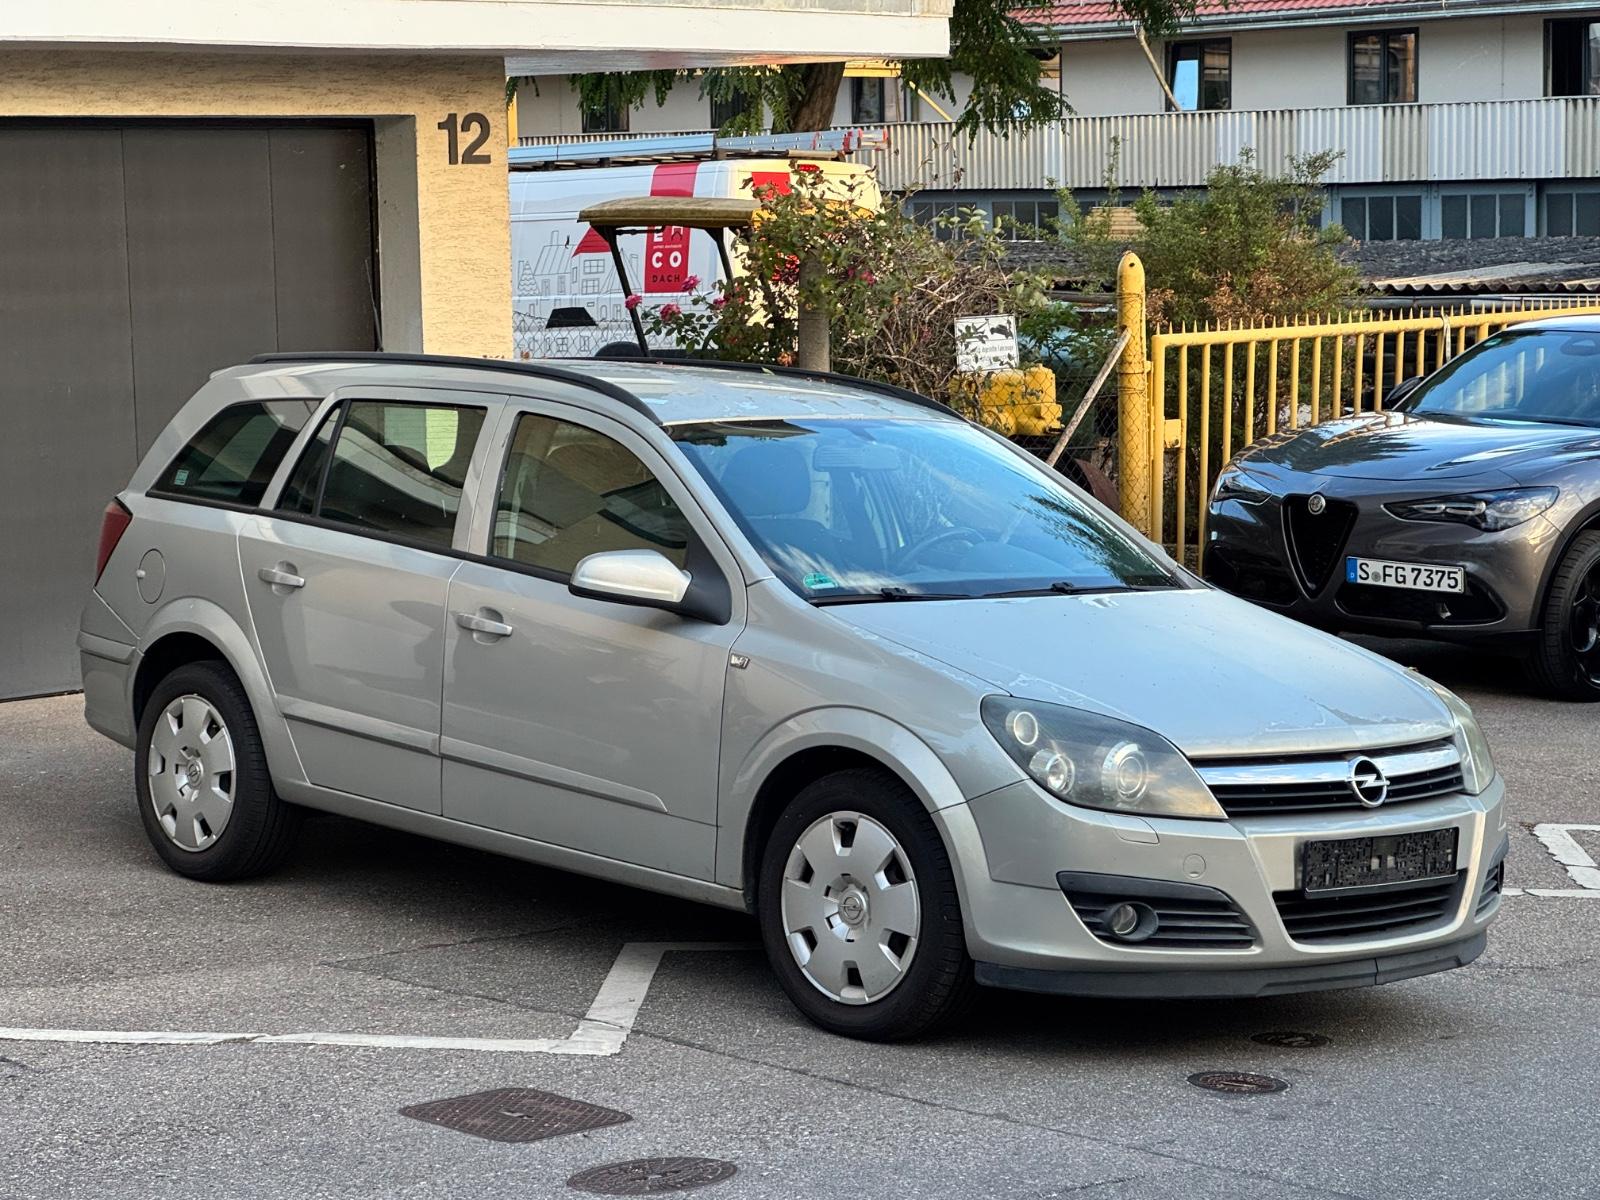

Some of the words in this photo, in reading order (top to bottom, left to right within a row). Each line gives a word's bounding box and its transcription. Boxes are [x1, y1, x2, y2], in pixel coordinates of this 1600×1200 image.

[437, 112, 491, 165] 12
[651, 250, 682, 269] CO
[652, 273, 680, 283] DACH
[1358, 562, 1370, 581] S
[1382, 564, 1407, 585] FG
[1410, 567, 1459, 589] 7375
